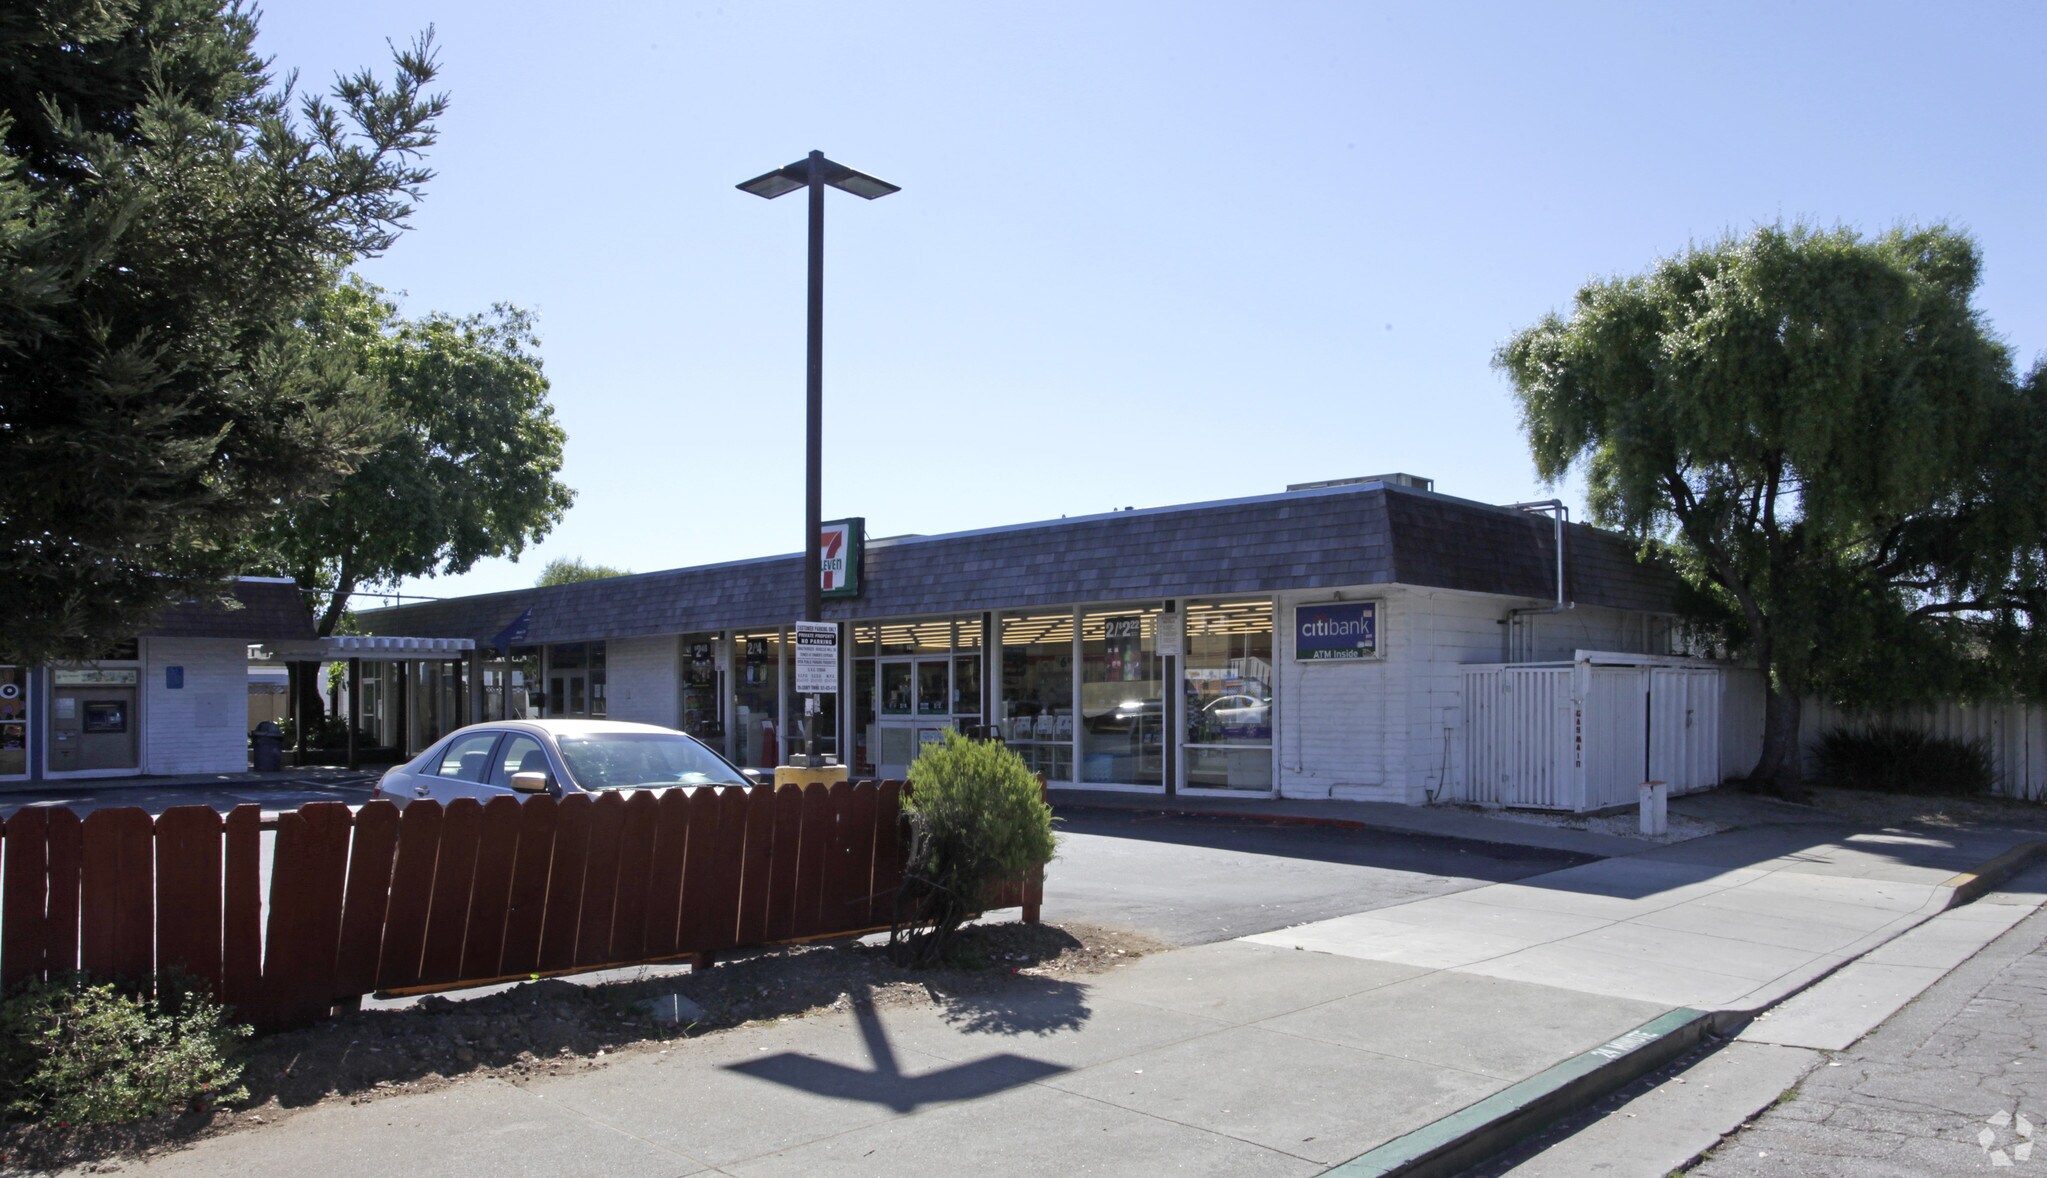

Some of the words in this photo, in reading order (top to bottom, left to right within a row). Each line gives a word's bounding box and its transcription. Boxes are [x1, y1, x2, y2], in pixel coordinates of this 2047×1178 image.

[1302, 616, 1369, 637] citibank
[1313, 650, 1332, 659] ATM
[1333, 649, 1359, 658] Inside
[1591, 1048, 1622, 1059] 24
